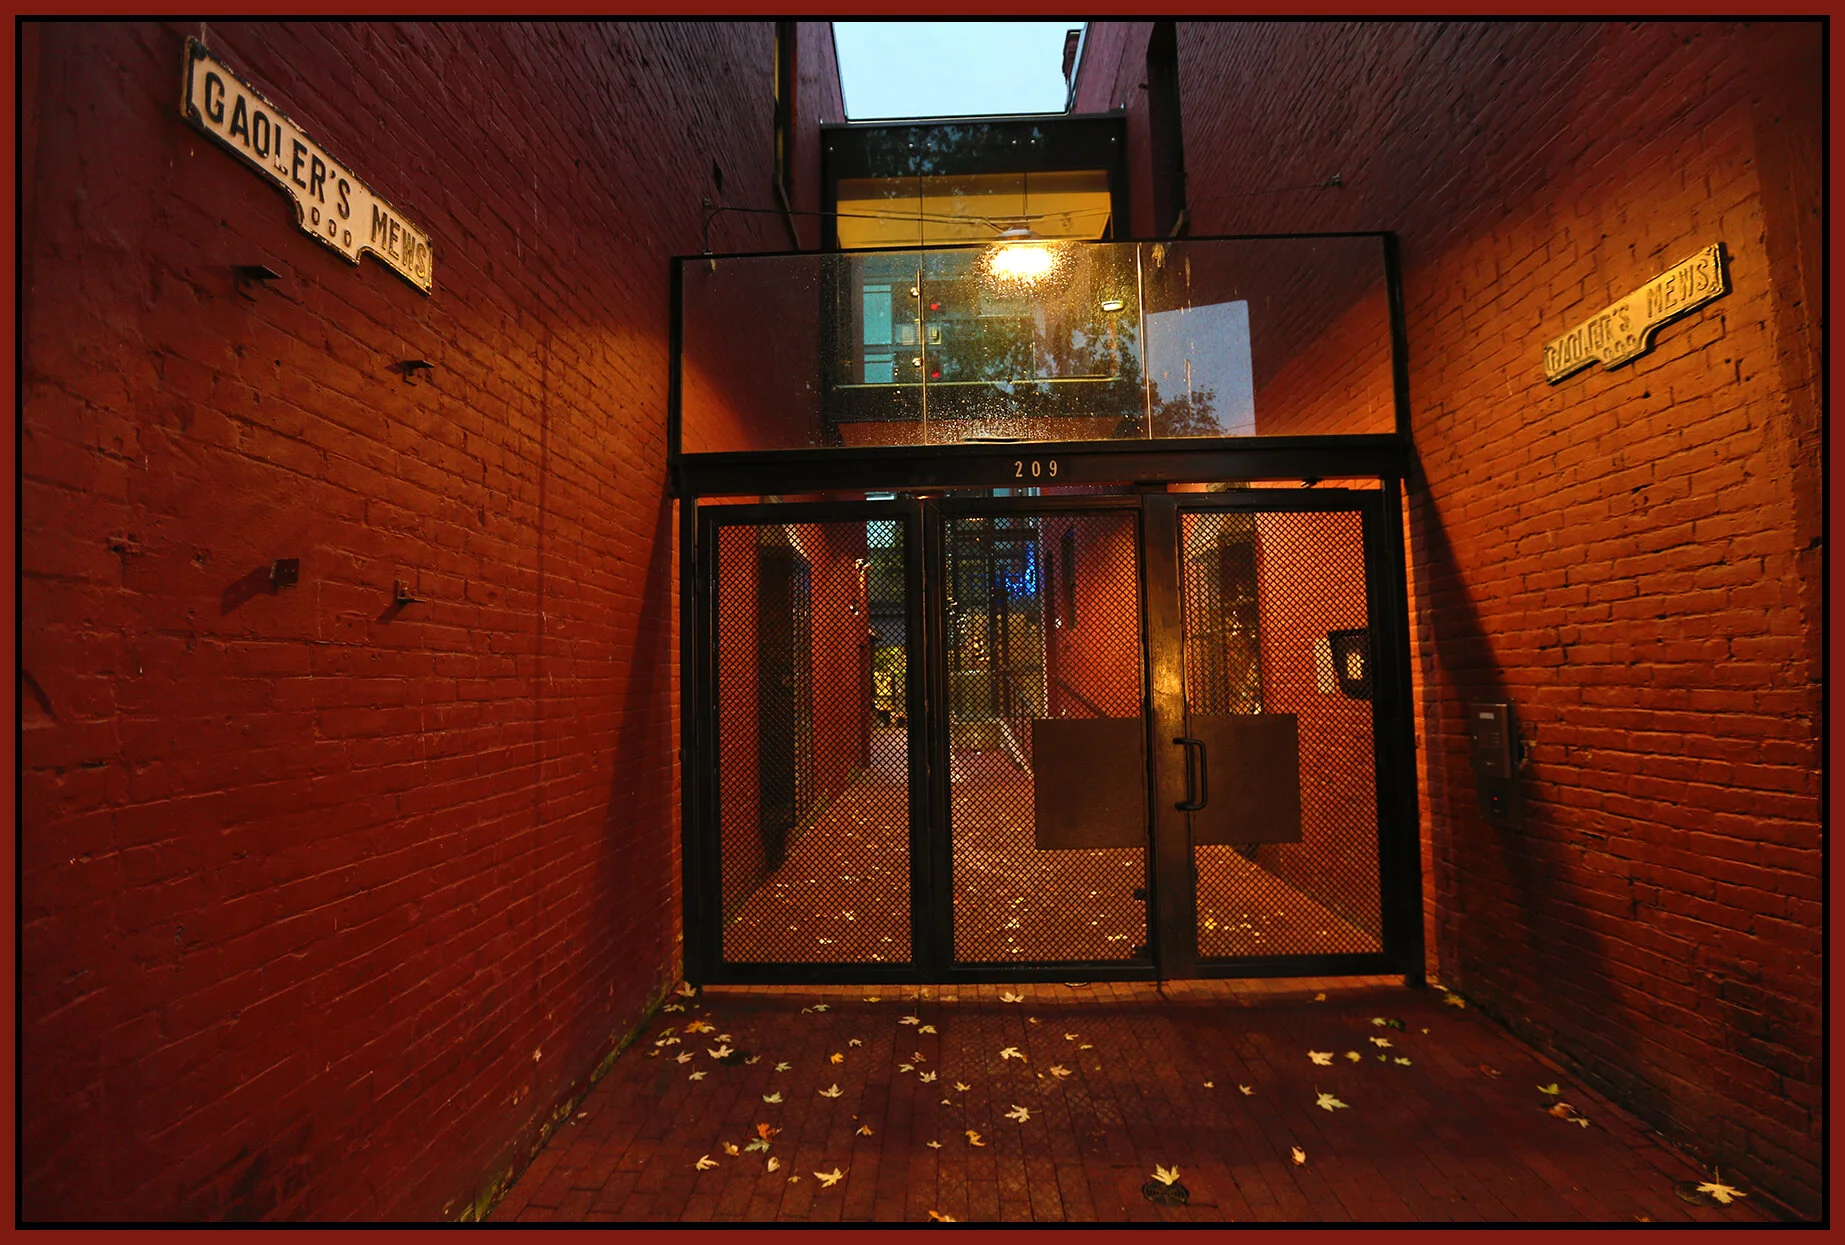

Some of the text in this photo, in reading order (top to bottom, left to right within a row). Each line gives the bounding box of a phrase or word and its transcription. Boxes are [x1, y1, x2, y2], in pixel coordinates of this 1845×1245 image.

[204, 71, 427, 278] GAOLER'S MEWS
[1547, 259, 1709, 371] GAOLER'S MEWS
[1014, 460, 1058, 477] 209
